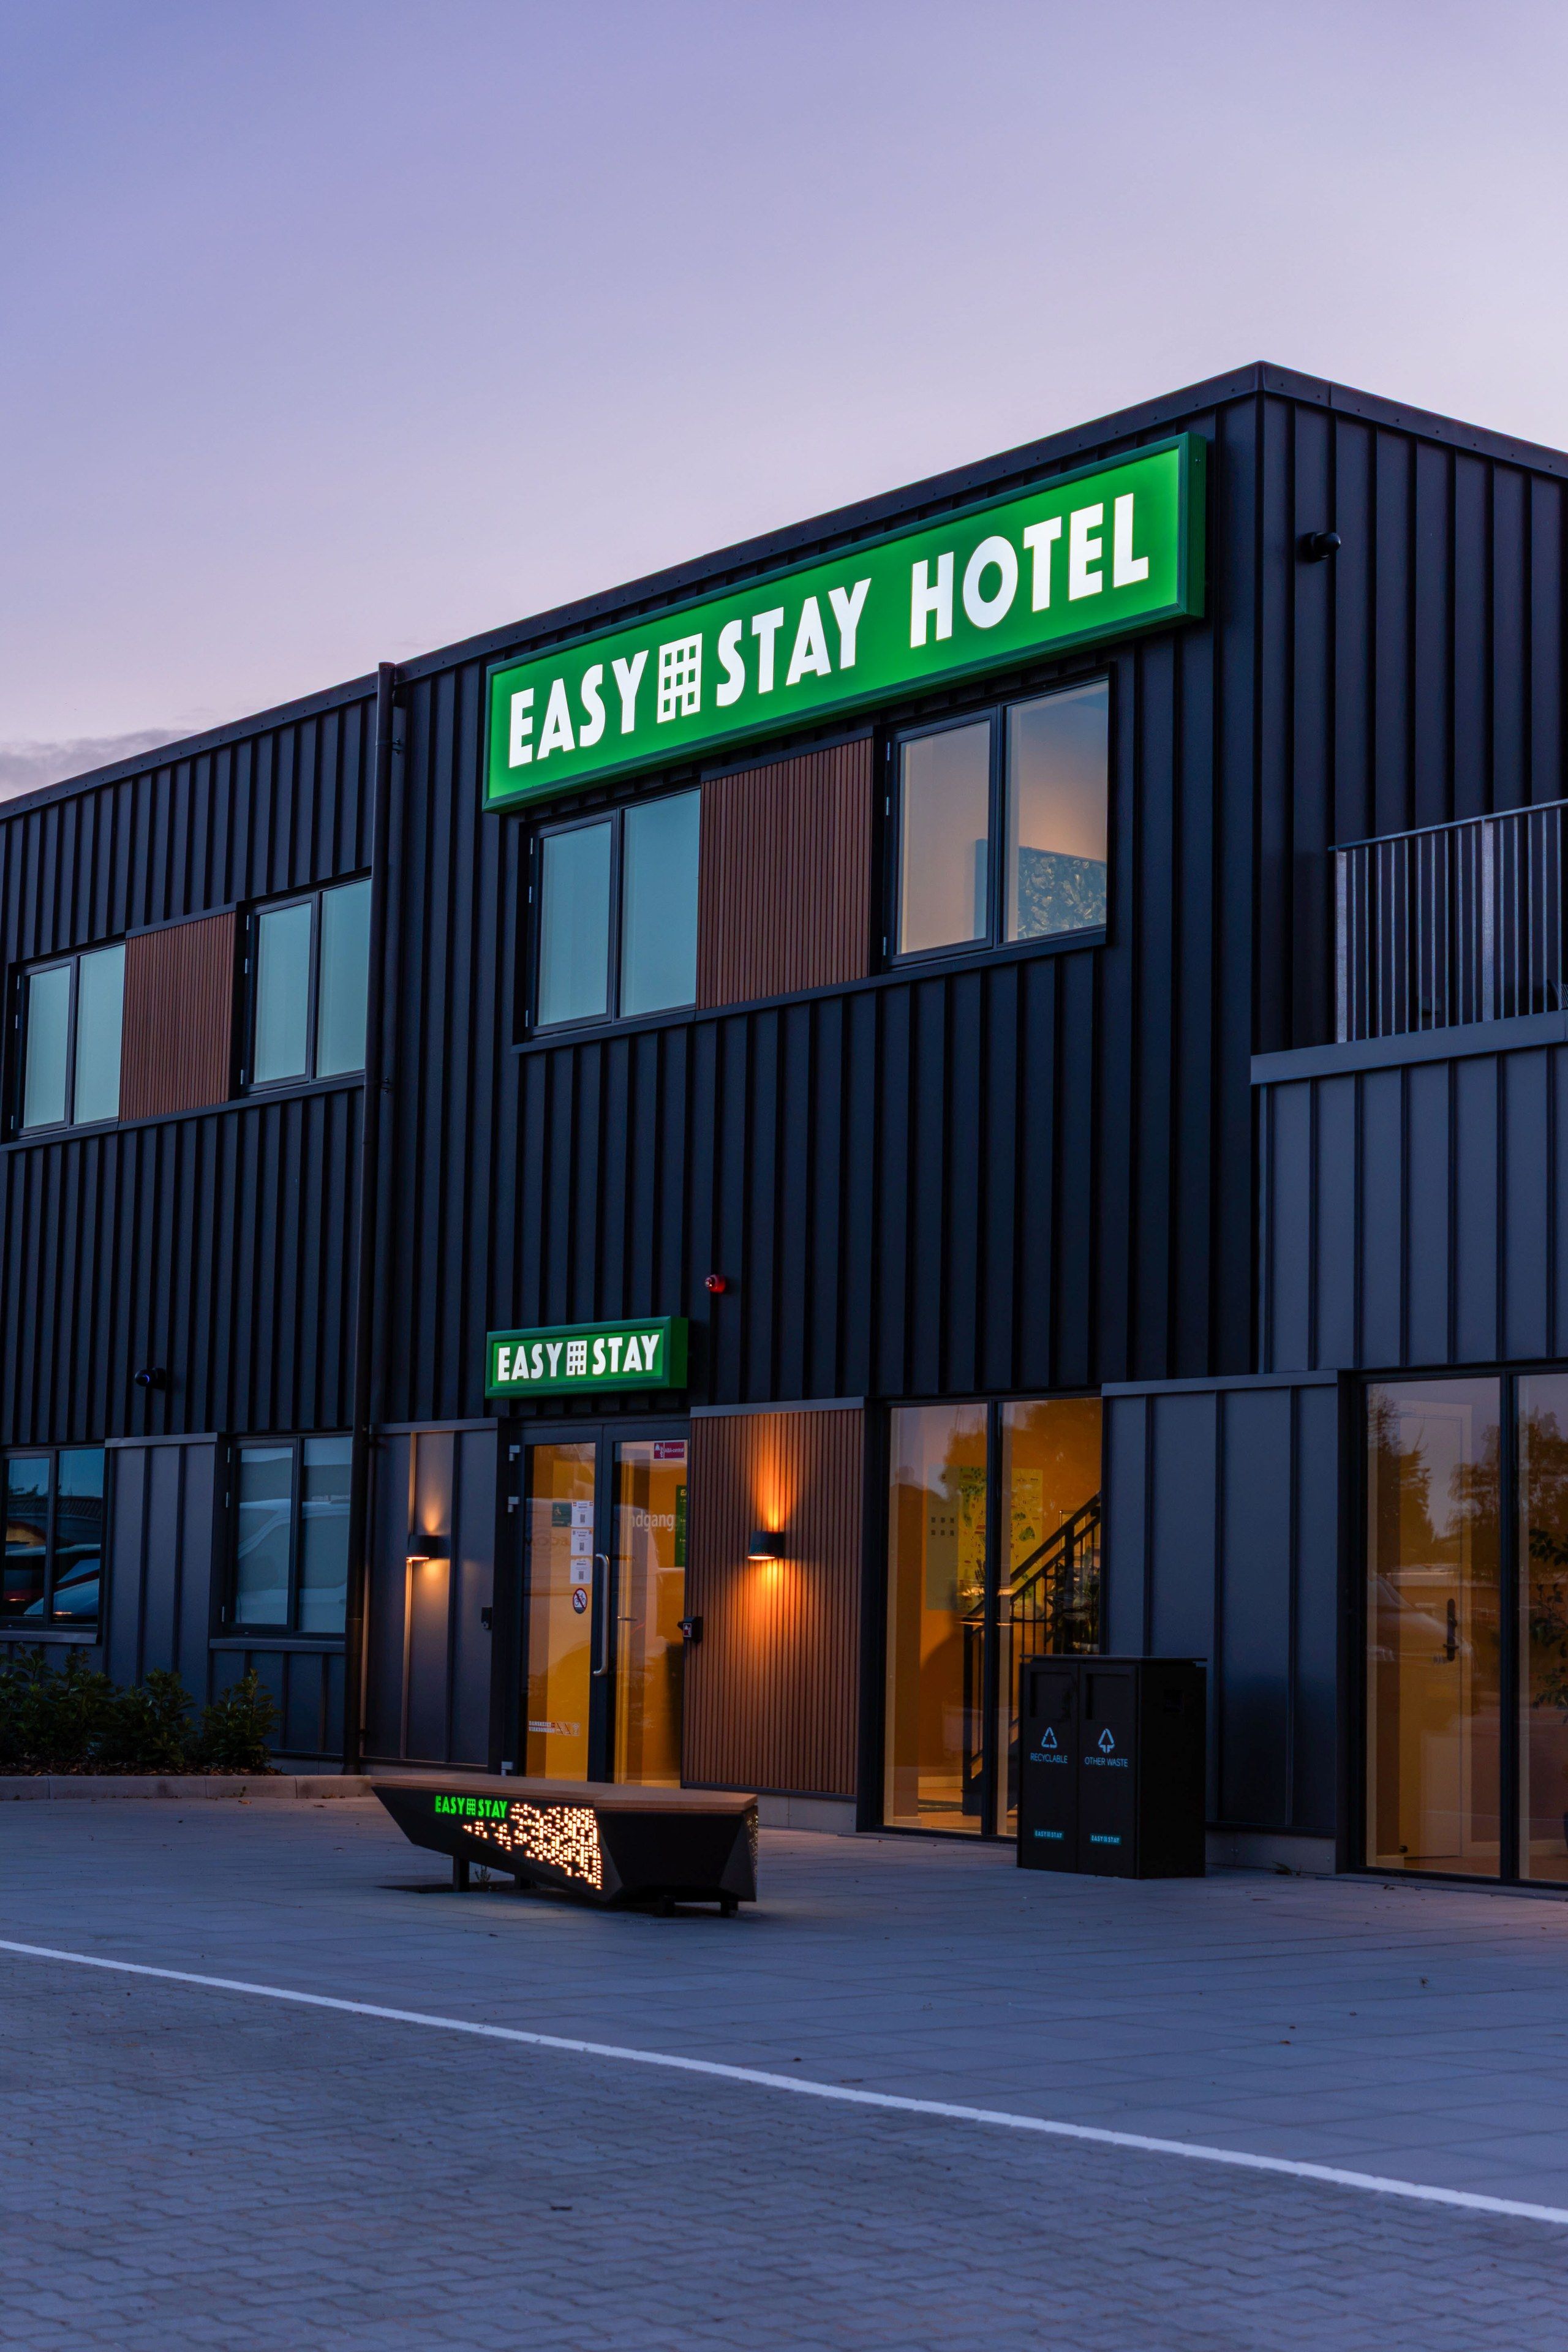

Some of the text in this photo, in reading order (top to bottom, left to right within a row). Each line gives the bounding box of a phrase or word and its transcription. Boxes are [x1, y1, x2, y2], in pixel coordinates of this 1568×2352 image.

[508, 492, 1148, 768] EASY STAY HOTEL
[497, 1334, 660, 1381] EASY STAY
[1030, 1752, 1068, 1763] RECYCLABLE
[1085, 1757, 1128, 1767] OTHER WASTE
[435, 1796, 508, 1819] EASY STAY
